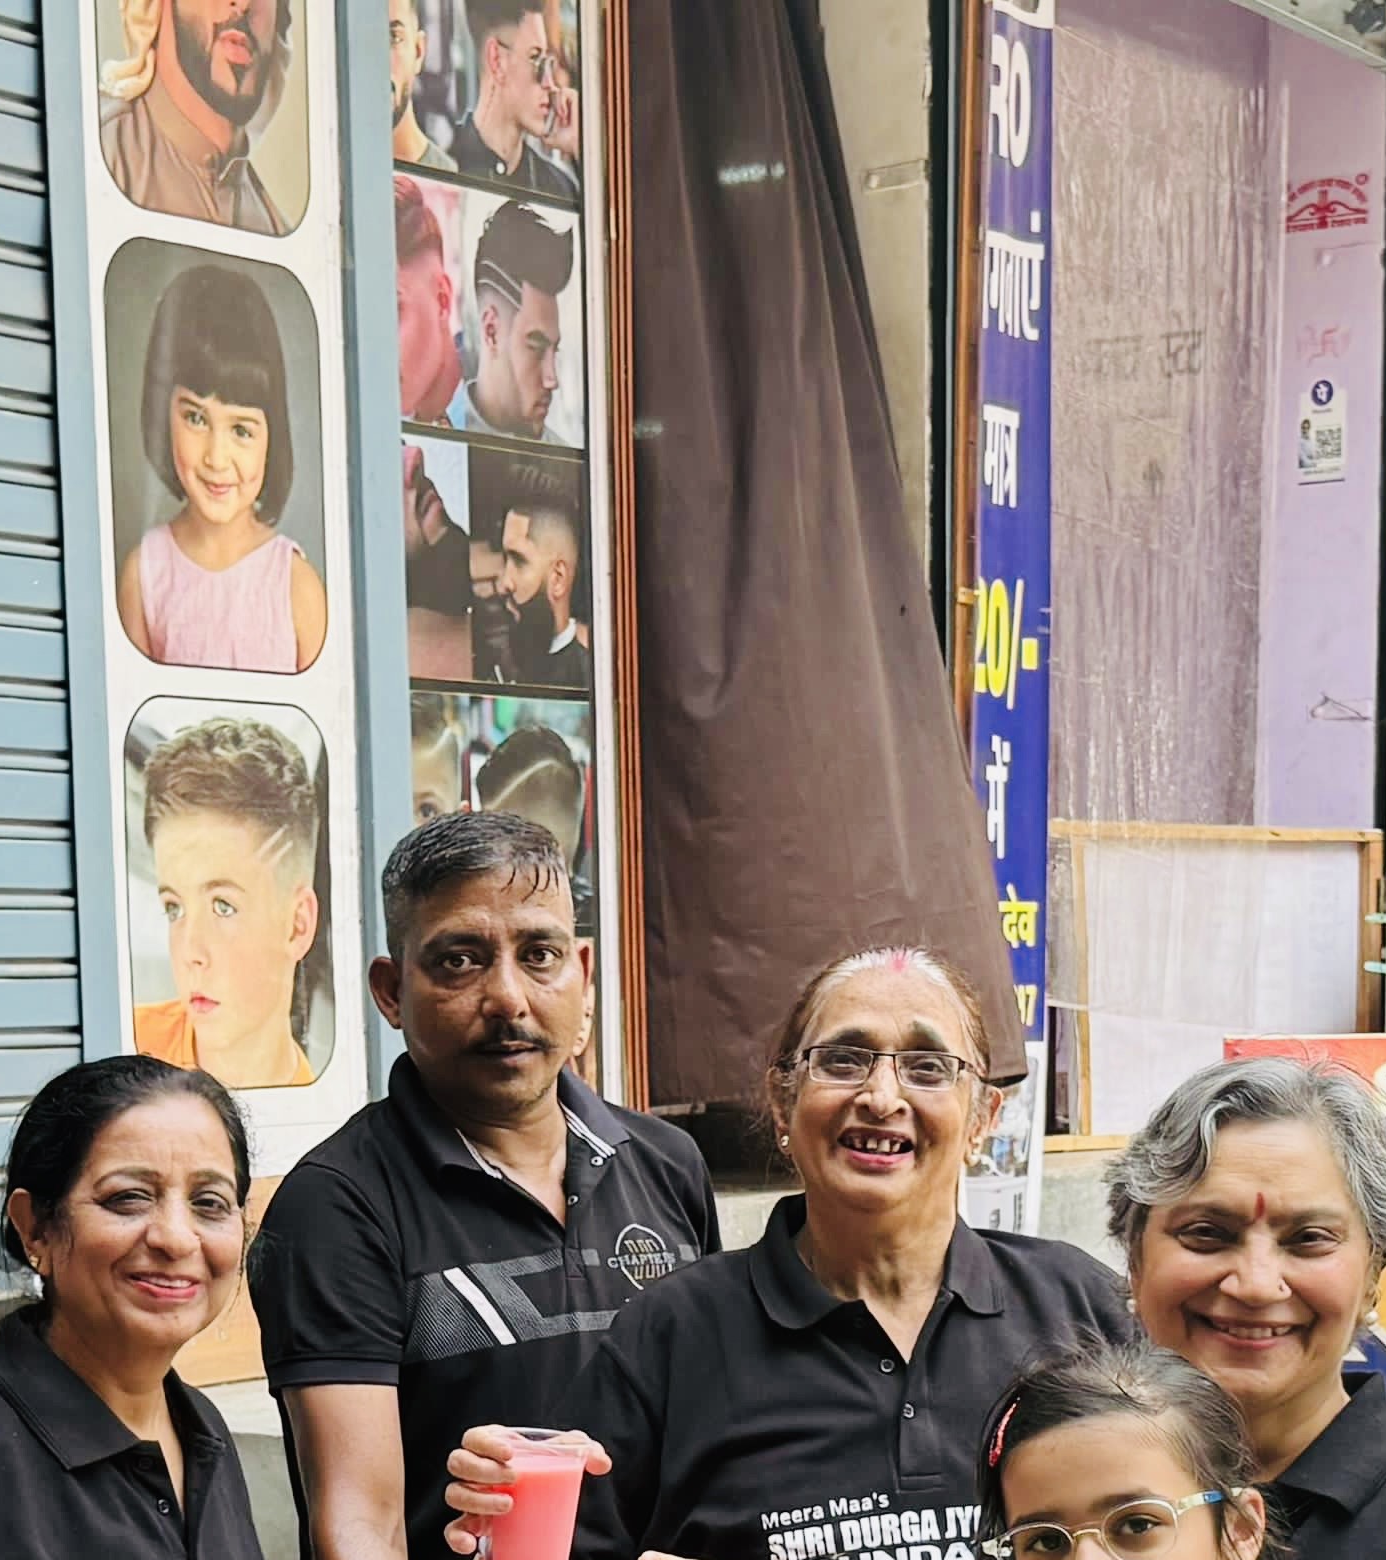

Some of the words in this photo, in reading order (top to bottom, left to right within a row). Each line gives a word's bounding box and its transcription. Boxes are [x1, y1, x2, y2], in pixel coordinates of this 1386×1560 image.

[761, 1505, 825, 1531] Meera
[829, 1492, 890, 1518] Maa's
[839, 1509, 942, 1552] DURGA
[945, 1504, 982, 1540] JY
